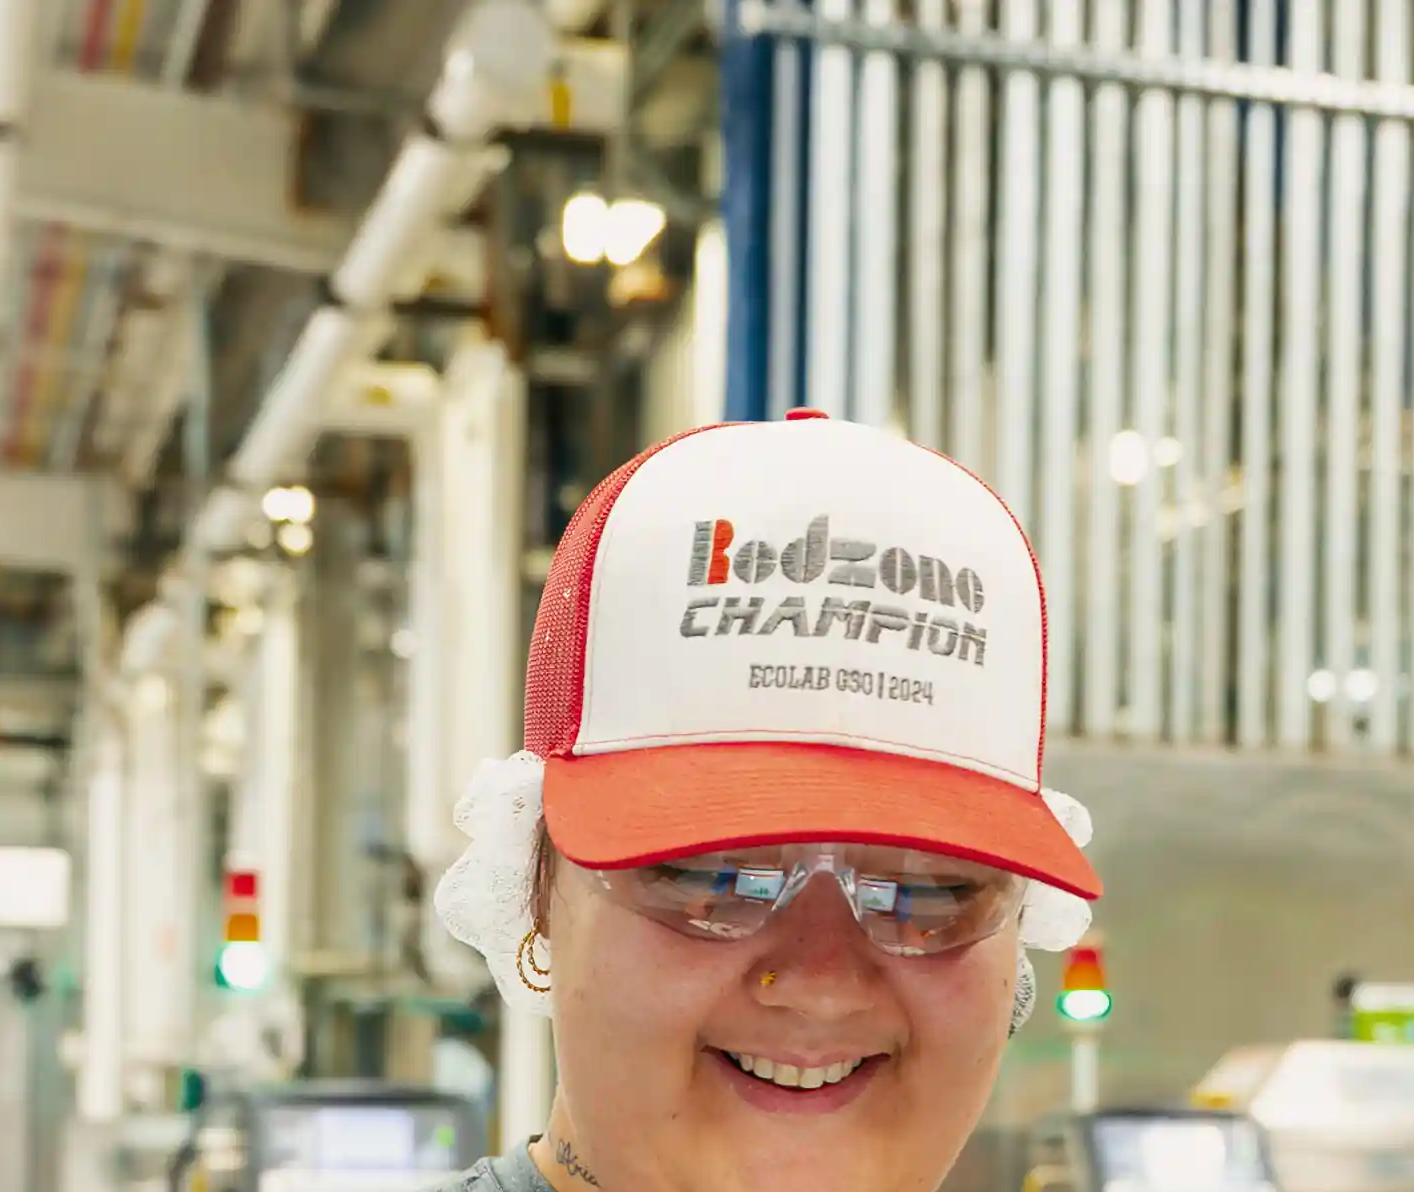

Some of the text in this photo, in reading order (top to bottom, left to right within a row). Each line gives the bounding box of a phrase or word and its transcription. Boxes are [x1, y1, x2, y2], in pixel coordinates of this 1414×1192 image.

[687, 514, 985, 614] Redzone
[680, 596, 987, 667] CHAMPION
[749, 664, 831, 690] ECOLAB
